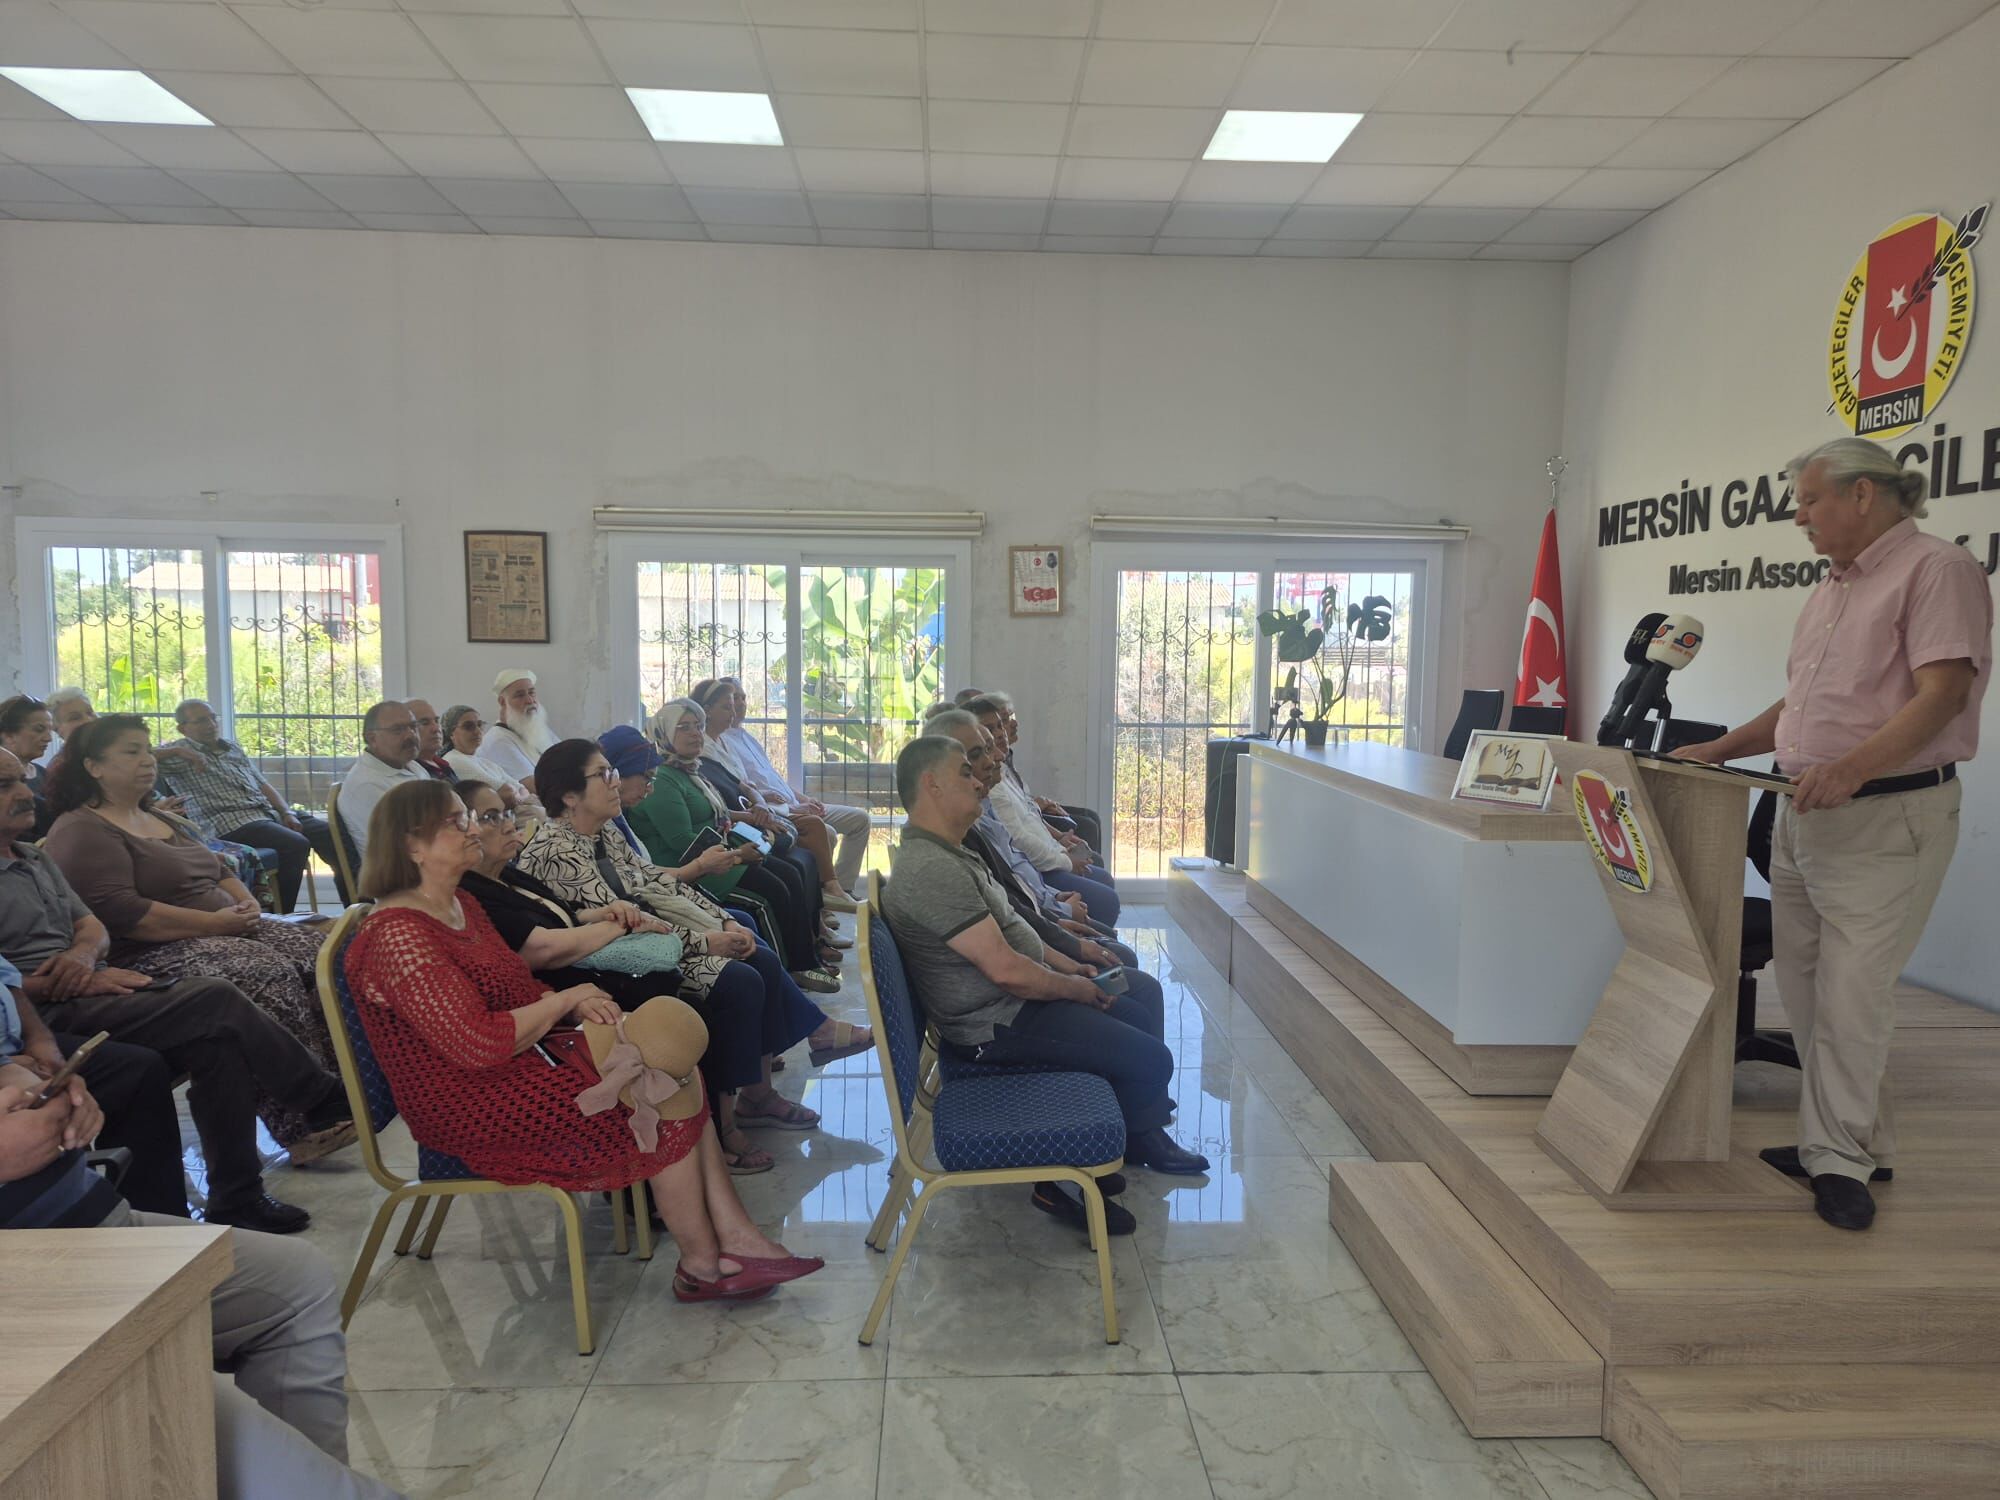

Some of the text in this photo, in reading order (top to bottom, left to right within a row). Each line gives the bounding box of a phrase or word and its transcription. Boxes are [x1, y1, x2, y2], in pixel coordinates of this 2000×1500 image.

[1832, 275, 1865, 415] GAZETECİLER
[1933, 261, 1968, 381] CEMİYETİ
[1859, 394, 1920, 431] MERSİN
[1598, 479, 1712, 547] MERSİN
[1668, 560, 1742, 594] Mersin
[1745, 556, 1831, 590] Assoc
